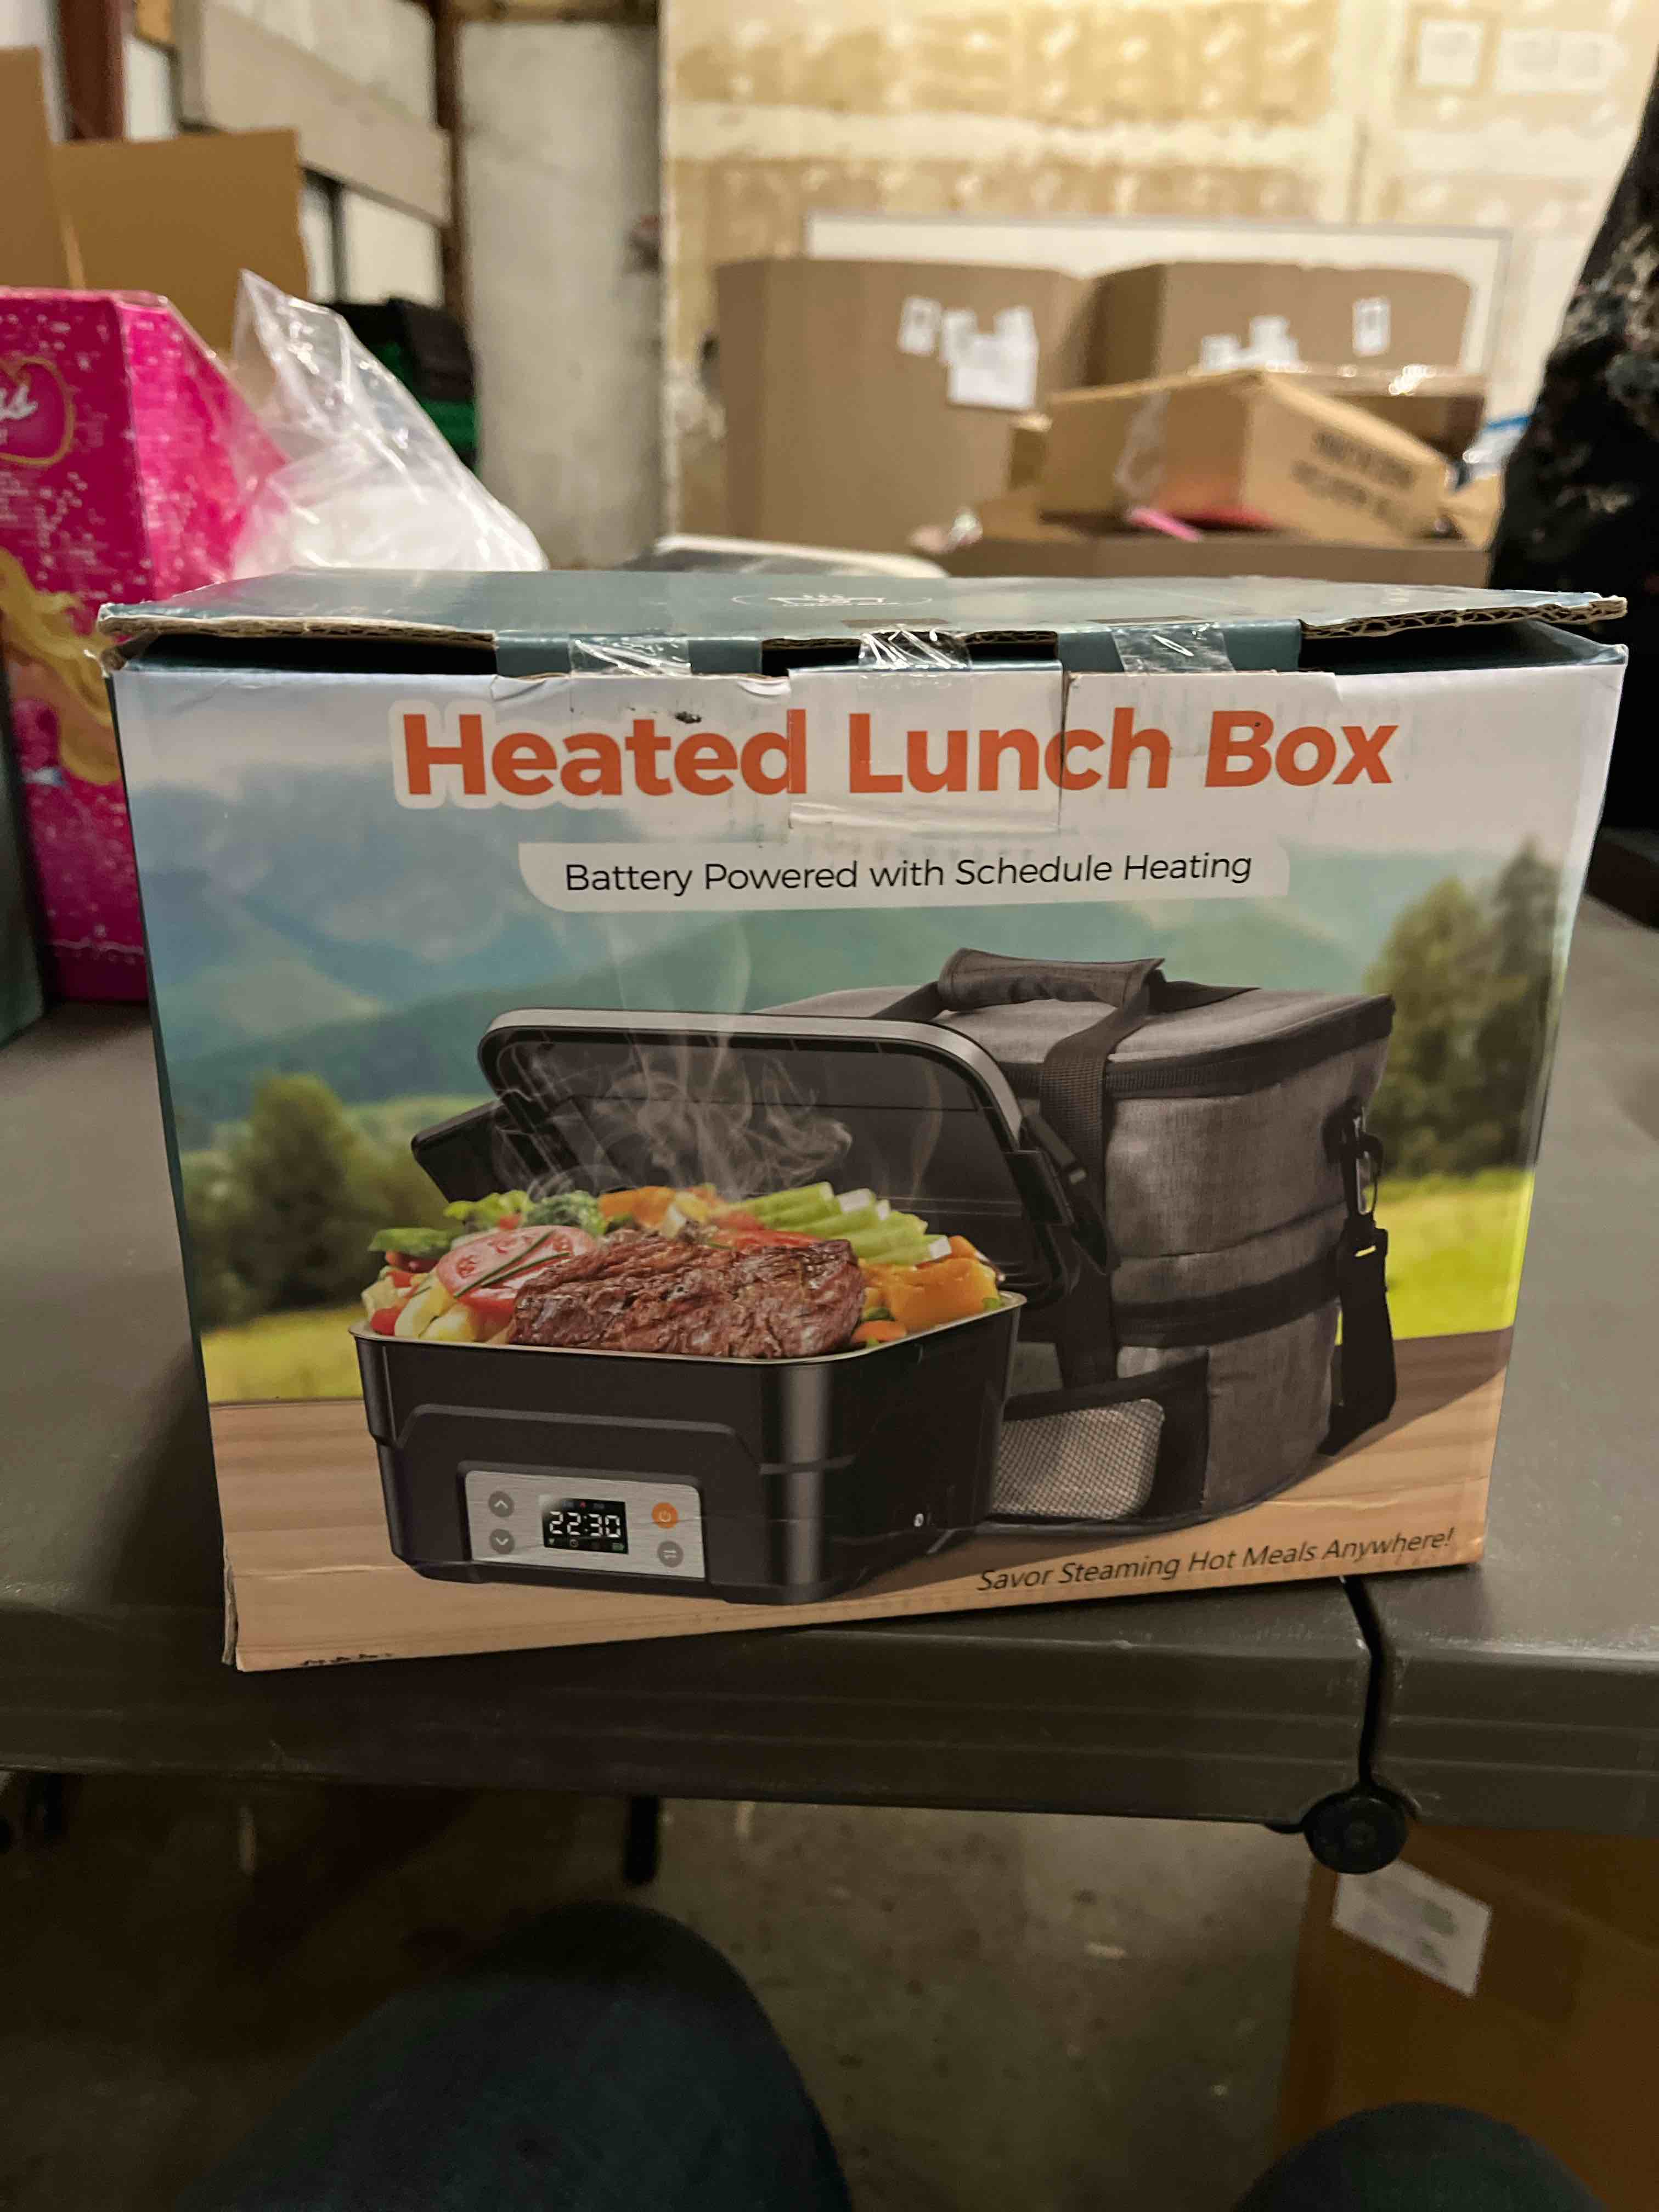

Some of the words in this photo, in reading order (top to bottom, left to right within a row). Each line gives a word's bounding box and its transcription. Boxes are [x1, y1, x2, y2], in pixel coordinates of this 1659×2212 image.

[403, 709, 807, 796] Heated
[848, 707, 1172, 794] Lunch
[1204, 710, 1399, 788] Box
[566, 863, 692, 897] Battery
[705, 860, 857, 890] Powered
[869, 858, 944, 887] with
[955, 853, 1113, 885] Schedule
[1123, 851, 1253, 884] Heating
[977, 1570, 1052, 1592] Savor
[1059, 1556, 1180, 1583] Steaming
[1187, 1550, 1238, 1572] Hot
[1242, 1541, 1317, 1567] Meals
[1321, 1527, 1455, 1561] Anywhere!
